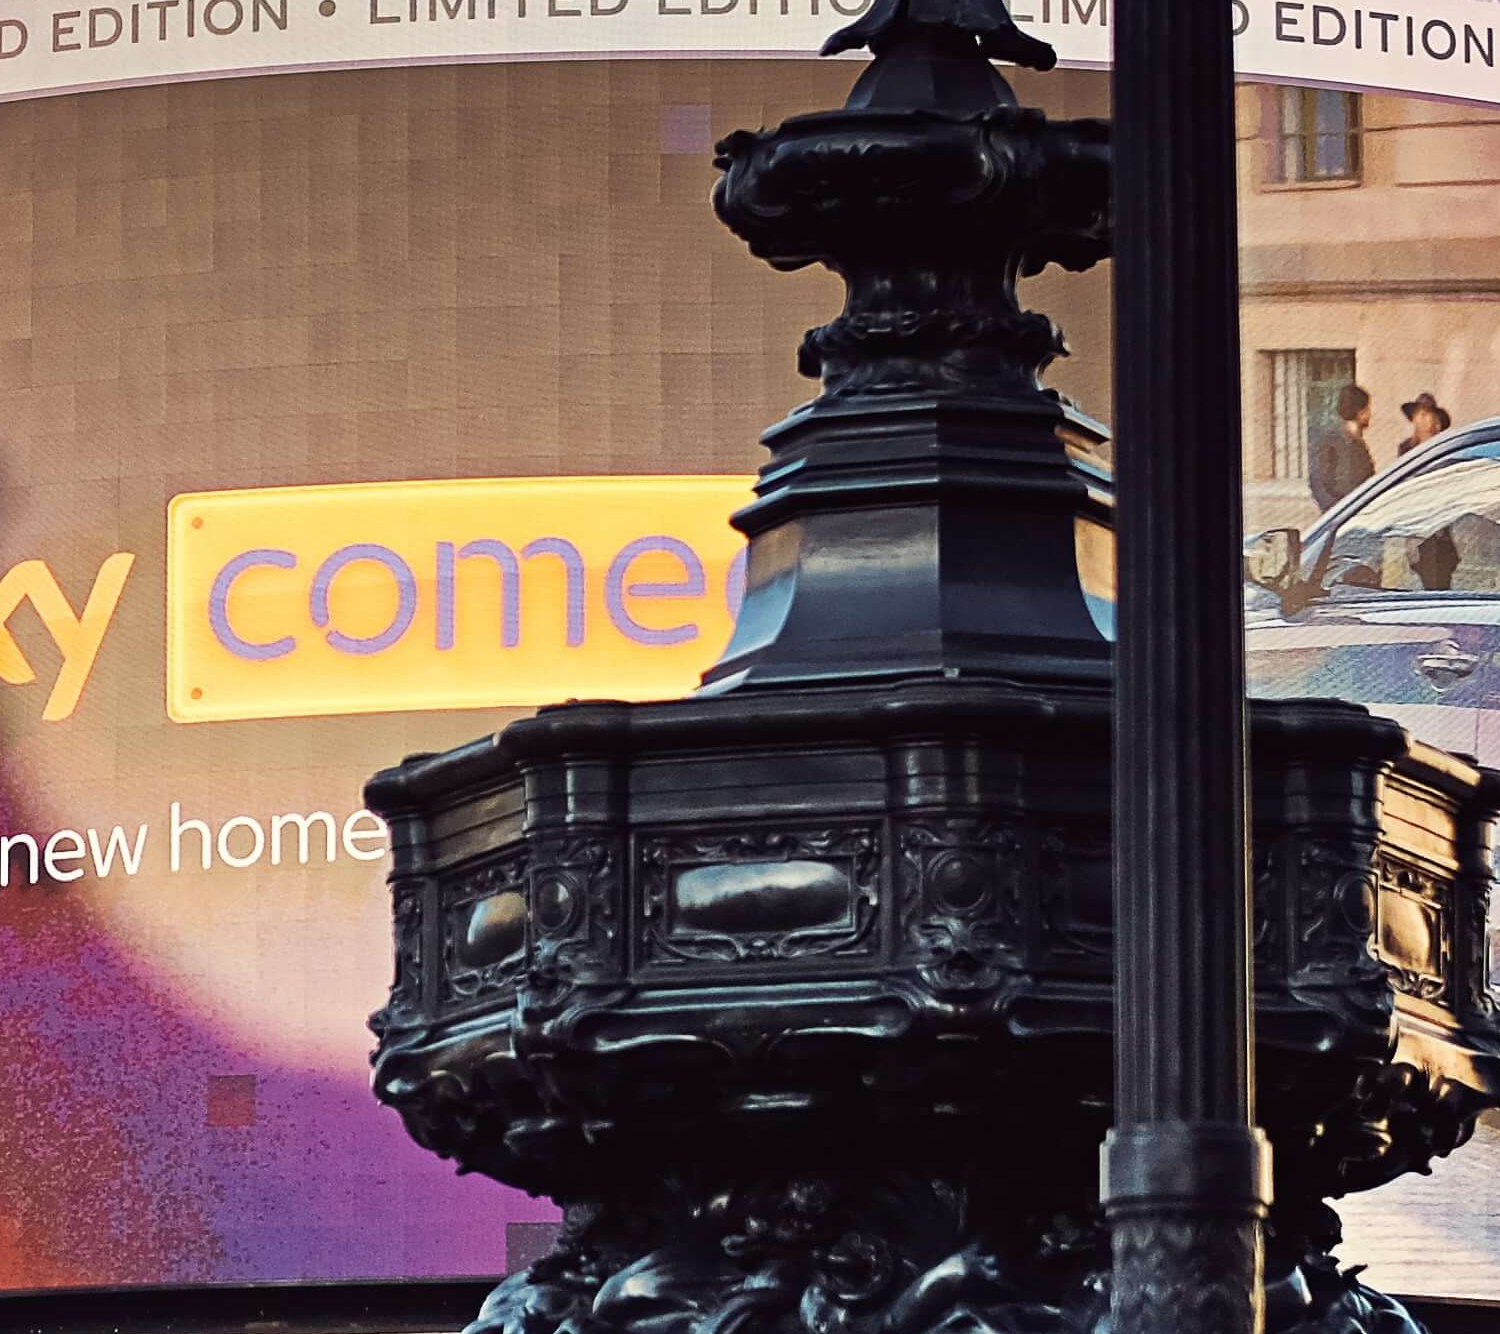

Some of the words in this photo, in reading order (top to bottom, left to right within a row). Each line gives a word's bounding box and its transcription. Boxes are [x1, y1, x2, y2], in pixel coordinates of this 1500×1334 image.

[1274, 1, 1495, 68] EDITION
[205, 533, 748, 661] come
[168, 799, 388, 872] home
